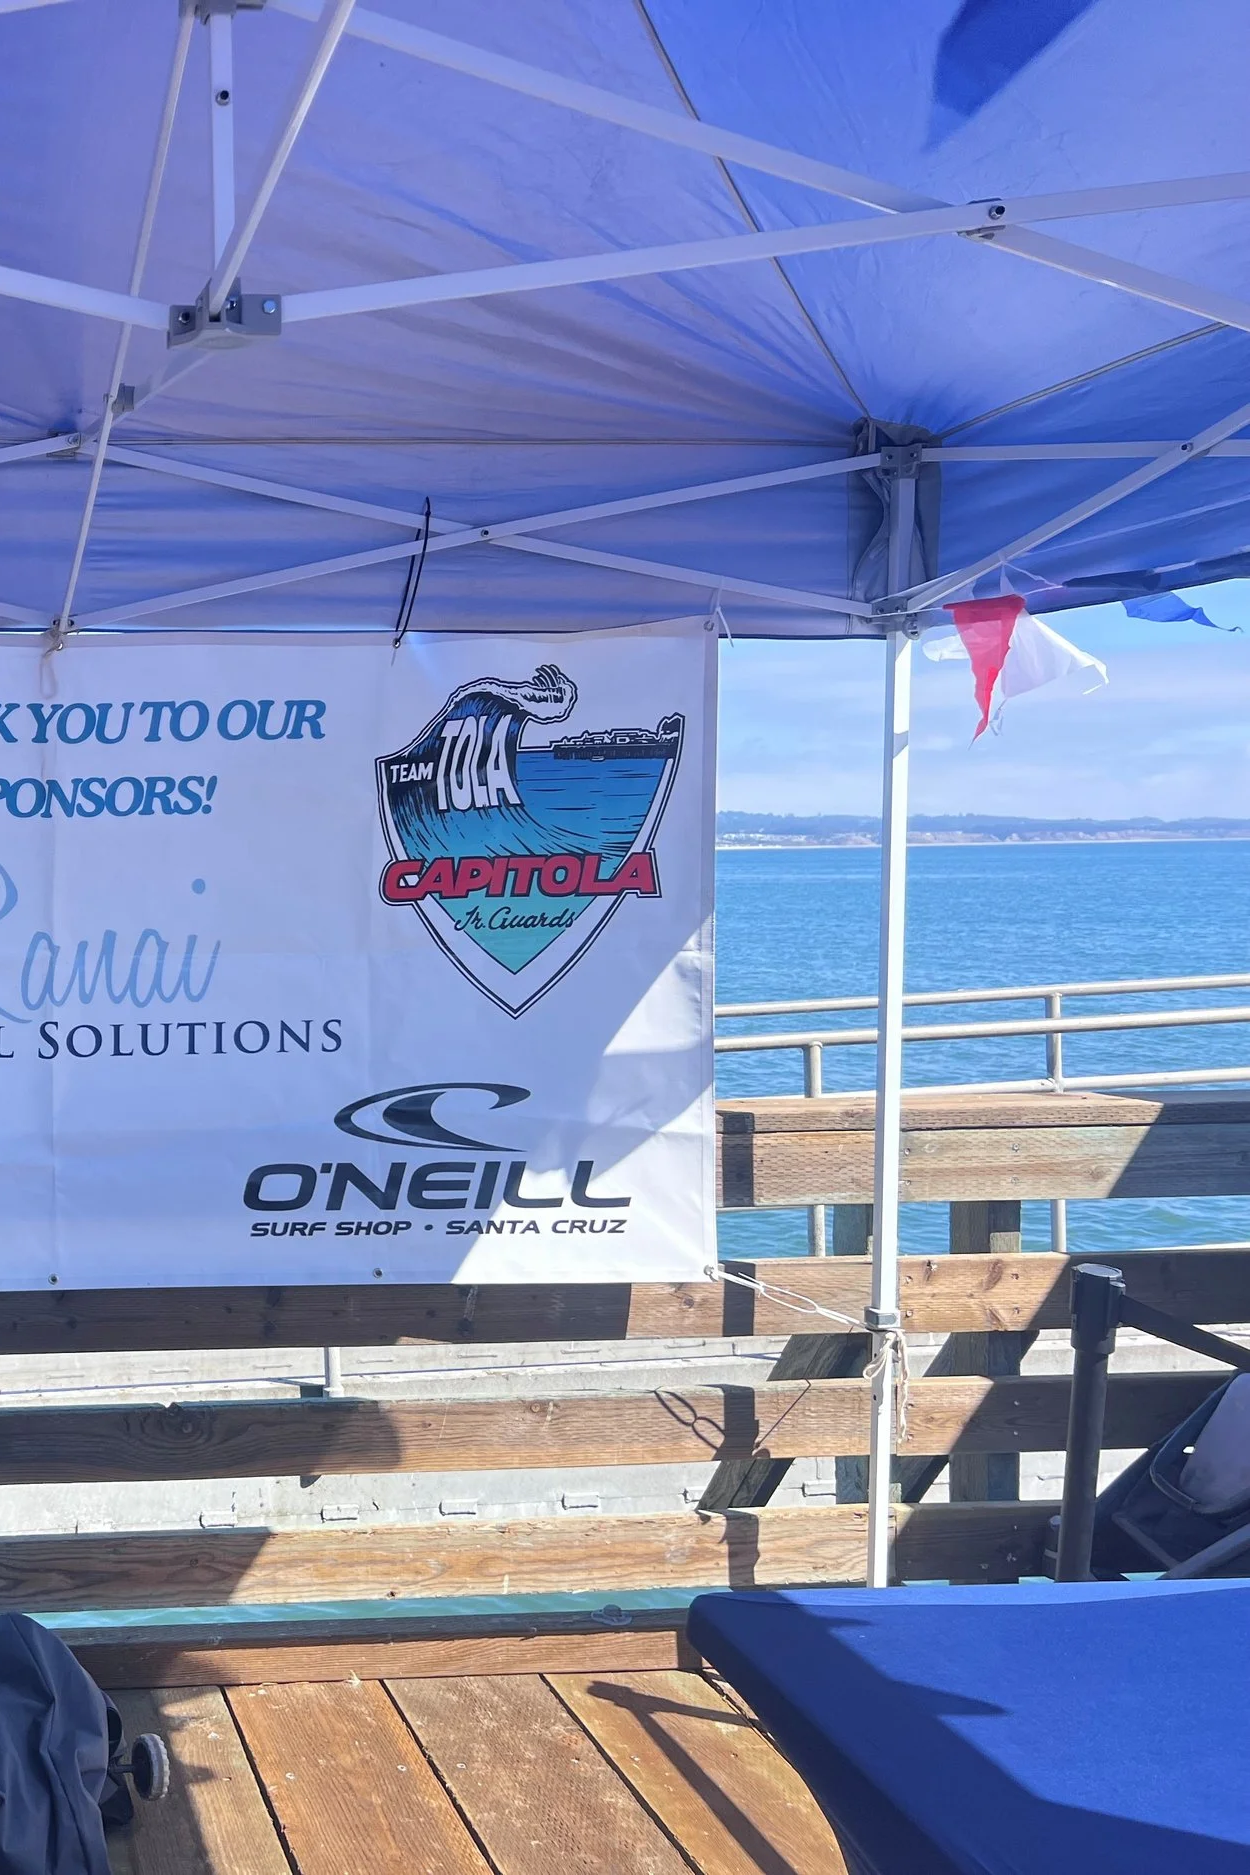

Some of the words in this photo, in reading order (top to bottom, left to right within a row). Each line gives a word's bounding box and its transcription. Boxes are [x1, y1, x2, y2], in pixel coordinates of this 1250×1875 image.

[26, 702, 135, 744] YOU
[139, 700, 210, 742] TO
[216, 699, 327, 741] OUR
[390, 762, 434, 784] TEAM
[435, 714, 522, 812] TOLA
[383, 851, 658, 901] CAPITOLA
[454, 905, 486, 931] Jr.
[488, 906, 576, 931] Guards
[37, 1018, 343, 1060] SOLUTIONS
[243, 1160, 632, 1212] O'NEILL
[250, 1221, 327, 1237] SURF
[334, 1220, 412, 1236] SHOP
[445, 1219, 541, 1236] SANTA
[551, 1218, 628, 1235] CRUZ
